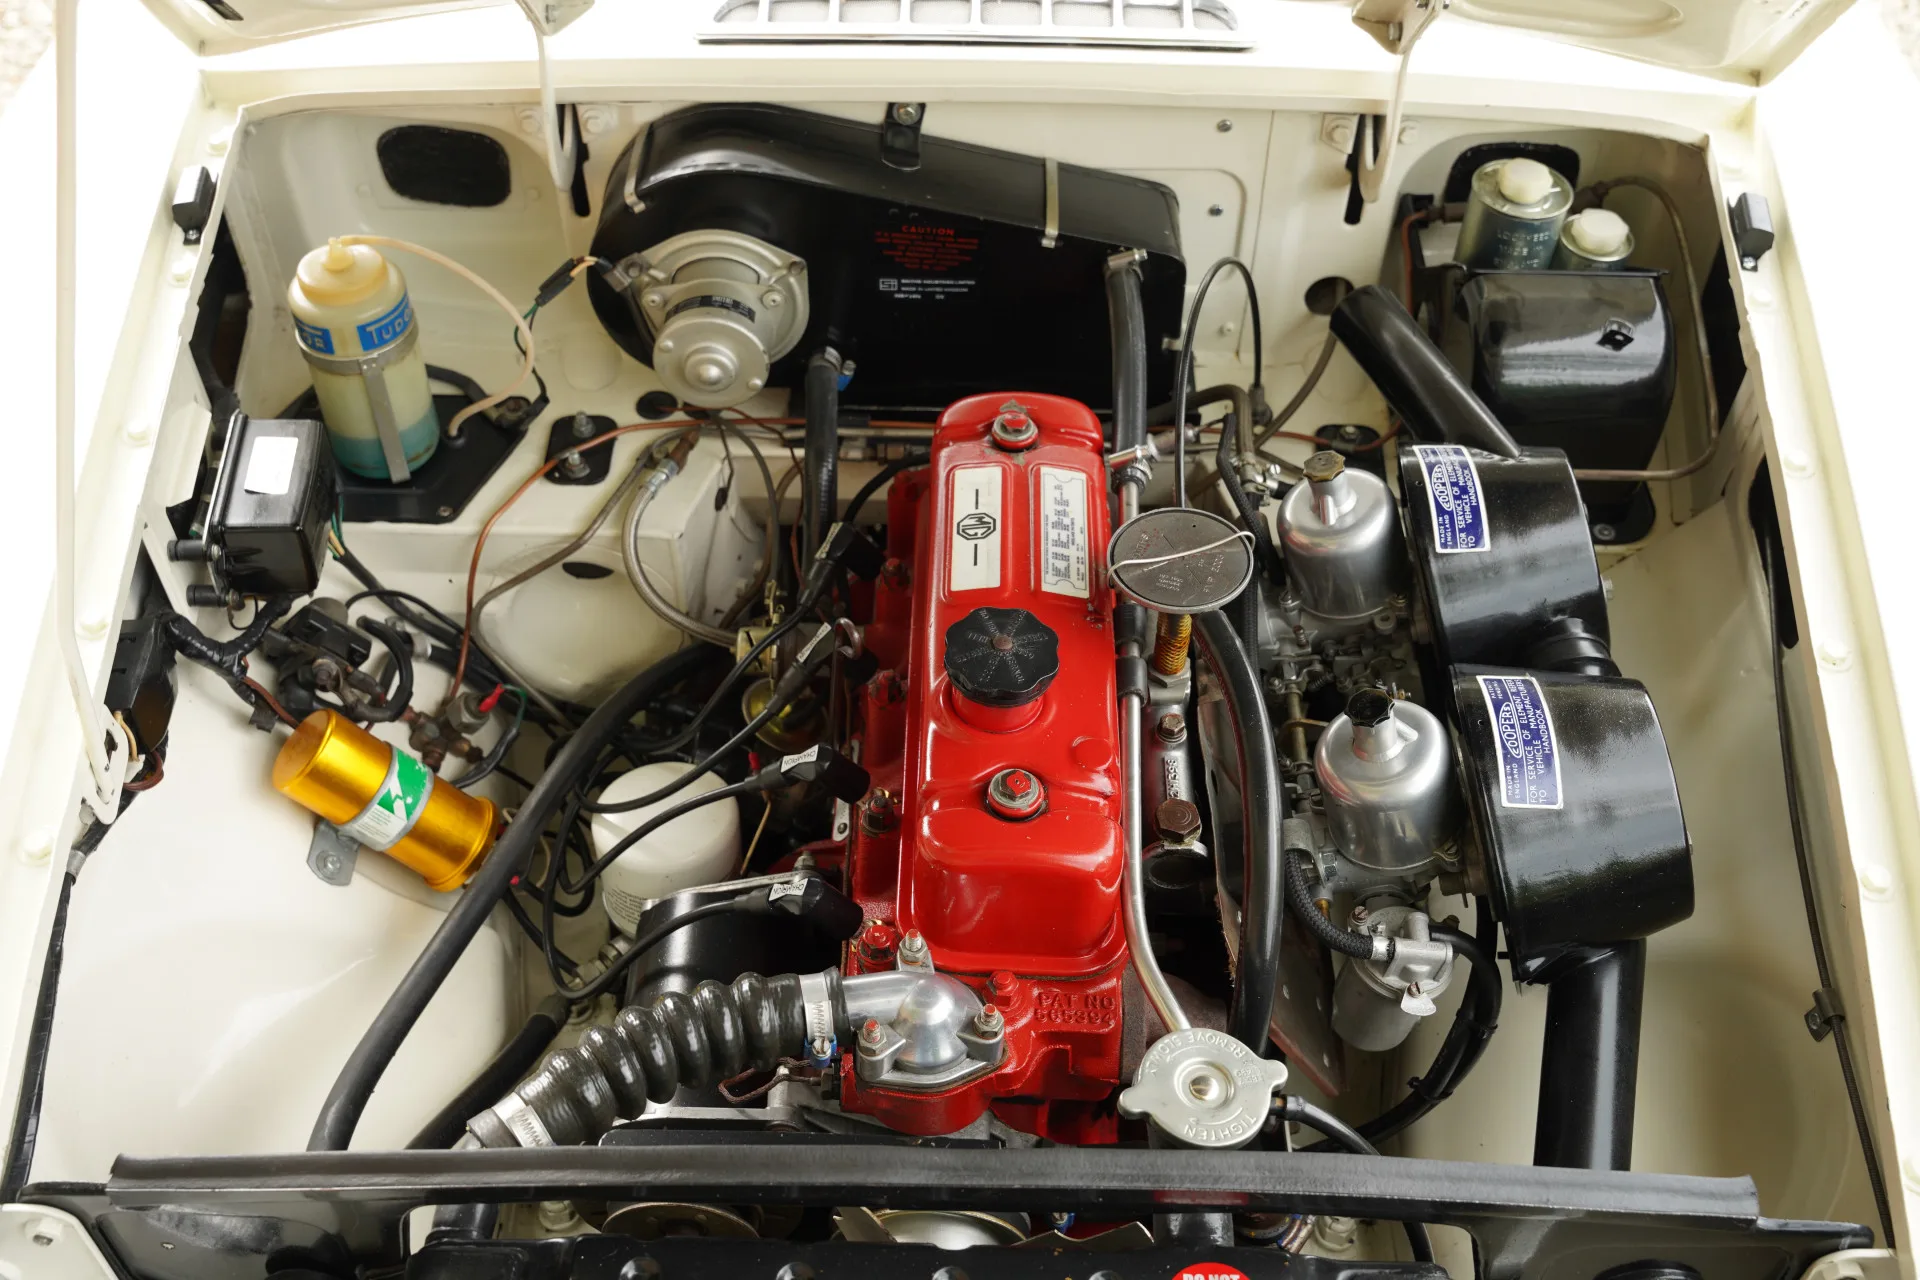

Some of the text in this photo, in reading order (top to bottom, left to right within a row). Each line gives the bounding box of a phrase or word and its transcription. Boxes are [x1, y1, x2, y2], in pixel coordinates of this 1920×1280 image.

[901, 225, 955, 236] CAUTION
[365, 301, 413, 345] TUDO
[1434, 465, 1453, 510] COOPERS
[1452, 486, 1460, 495] OF
[1438, 516, 1443, 524] IN
[1454, 500, 1466, 528] SERVICE
[1461, 494, 1473, 524] VEHICLE
[959, 514, 994, 538] MG
[1444, 514, 1452, 545] ENGLAND
[1460, 532, 1468, 548] FOR
[1468, 535, 1476, 547] TO
[1514, 695, 1528, 724] ELEMENT
[1501, 704, 1520, 754] COOPERS
[1522, 729, 1531, 740] OF
[783, 748, 817, 767] CHAMPION
[1506, 765, 1511, 773] IN
[1525, 745, 1537, 780] SERVICE
[1532, 739, 1546, 775] VEHICLE
[1512, 763, 1520, 799] ENGLAND
[1529, 785, 1537, 803] FOR
[1539, 789, 1547, 803] TO
[772, 882, 806, 896] CHAMPION
[1038, 993, 1115, 1010] PAT NO
[1145, 1031, 1246, 1074] REMOVE SLOWLY
[1183, 1113, 1257, 1141] TIGHTEN
